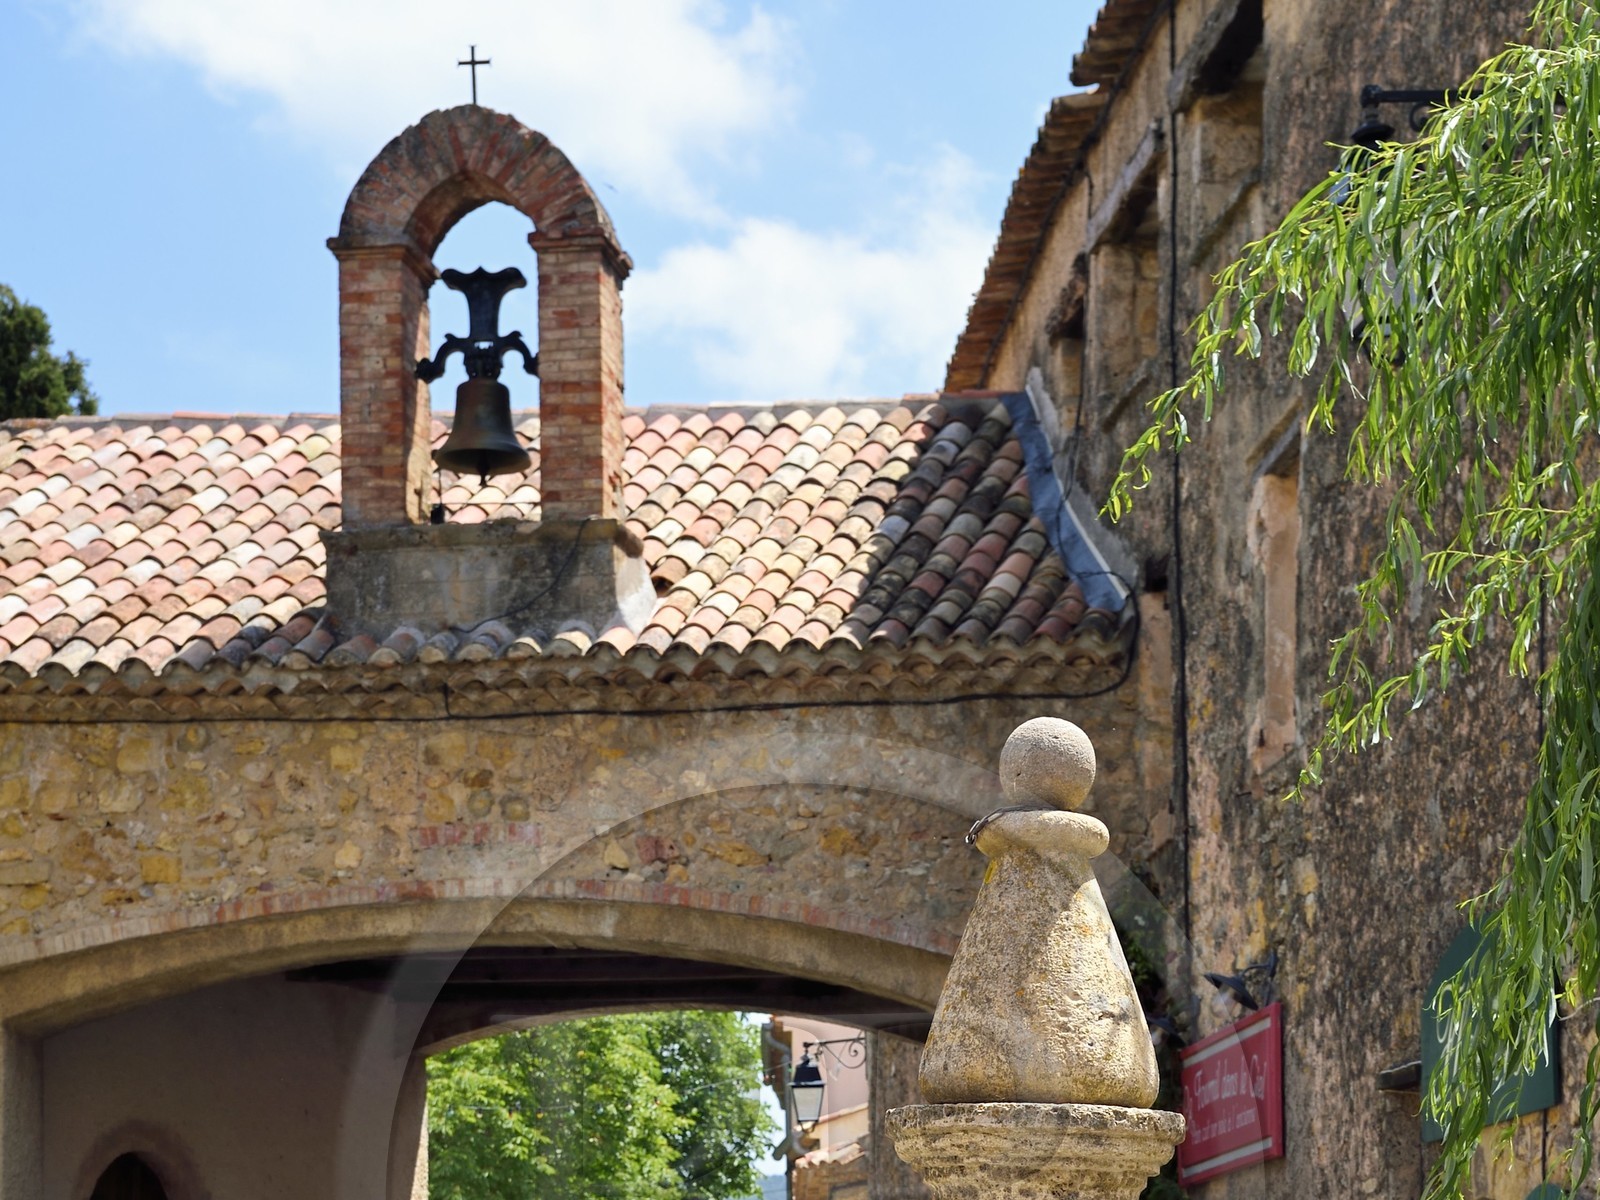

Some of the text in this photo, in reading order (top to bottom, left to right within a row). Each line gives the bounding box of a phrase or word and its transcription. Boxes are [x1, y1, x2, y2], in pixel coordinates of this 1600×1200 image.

[1221, 1058, 1239, 1099] dans
[1240, 1055, 1247, 1095] le
[1248, 1054, 1267, 1101] Ciel
